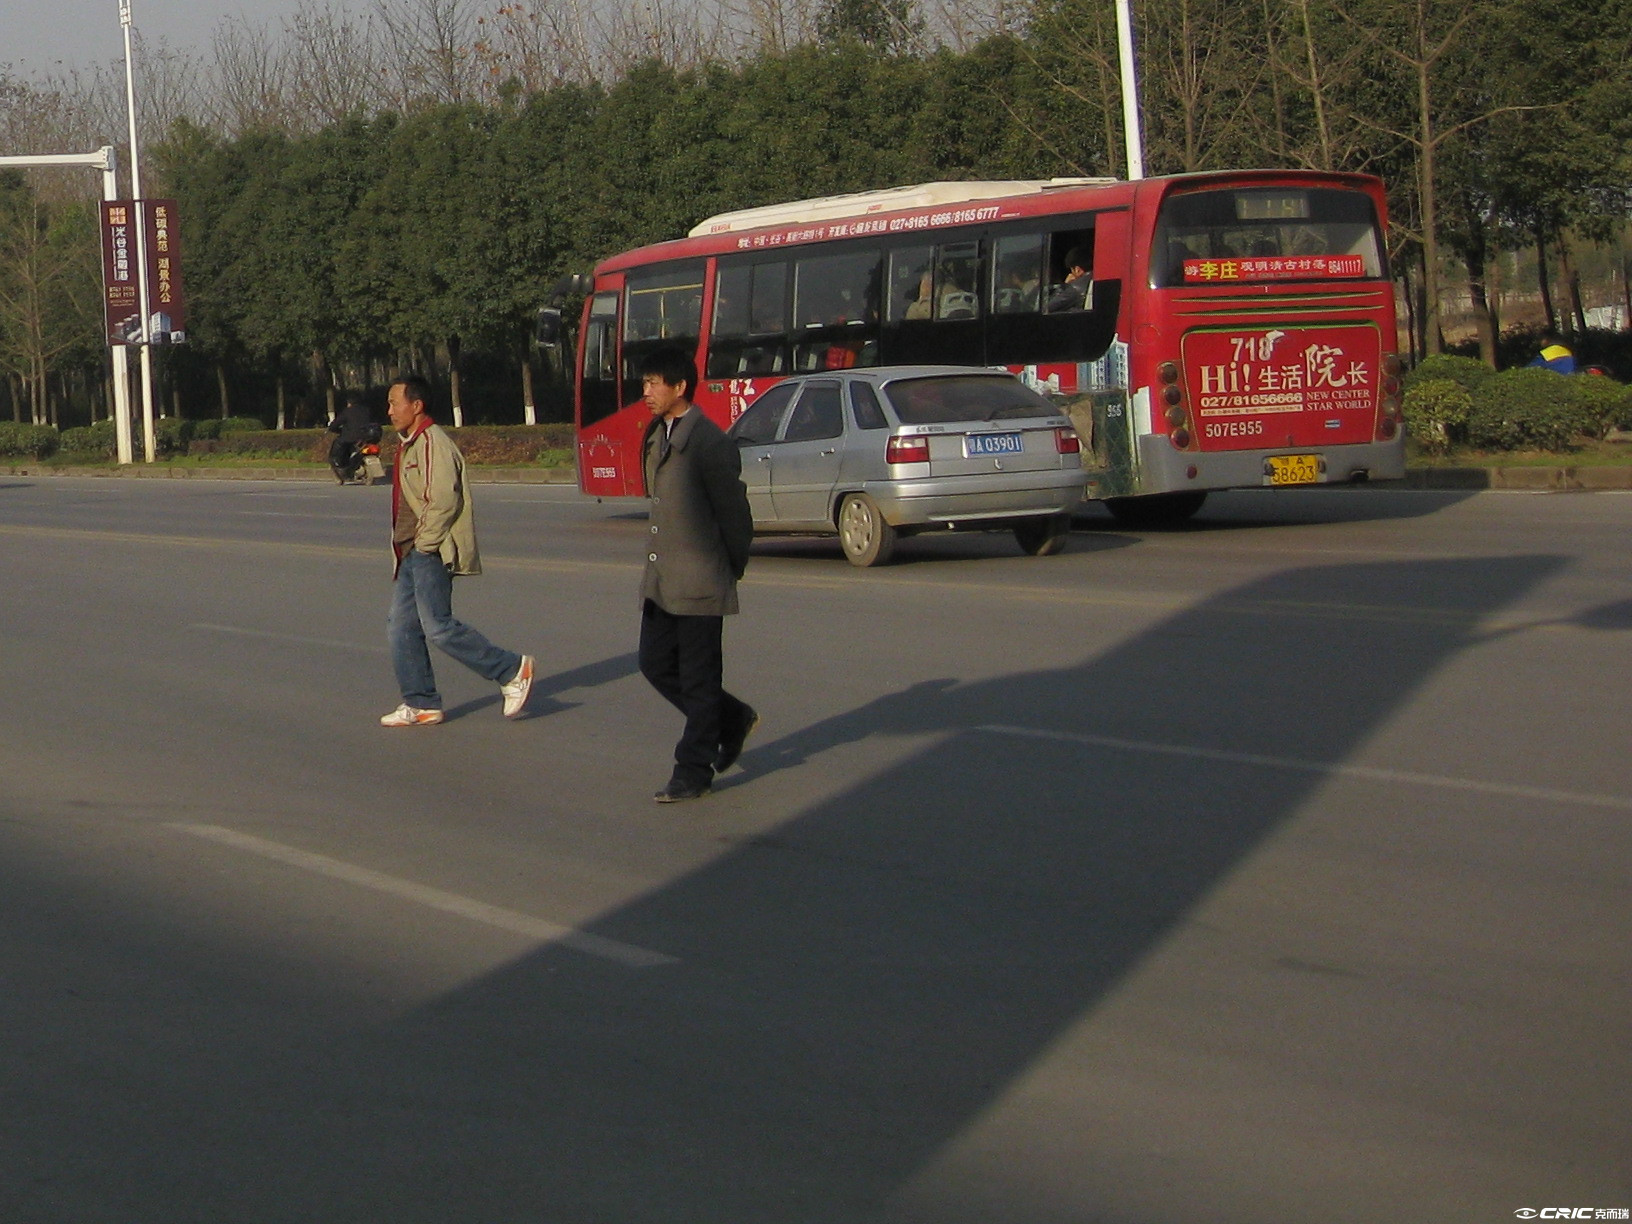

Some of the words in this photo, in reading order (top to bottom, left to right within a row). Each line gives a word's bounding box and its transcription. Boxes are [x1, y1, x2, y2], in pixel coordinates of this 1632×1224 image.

[1199, 261, 1239, 280] 李庄
[1230, 336, 1272, 362] 718
[1200, 362, 1251, 394] Hi!
[1258, 343, 1368, 391] 生活院长
[1200, 392, 1303, 408] 027/81656666
[1306, 391, 1329, 401] NEW
[1332, 389, 1370, 399] CENTER
[1306, 402, 1333, 412] STAR
[1335, 399, 1371, 410] WORLD
[1205, 421, 1263, 438] 507E955
[986, 434, 1021, 452] 03901
[1272, 465, 1315, 482] 58623
